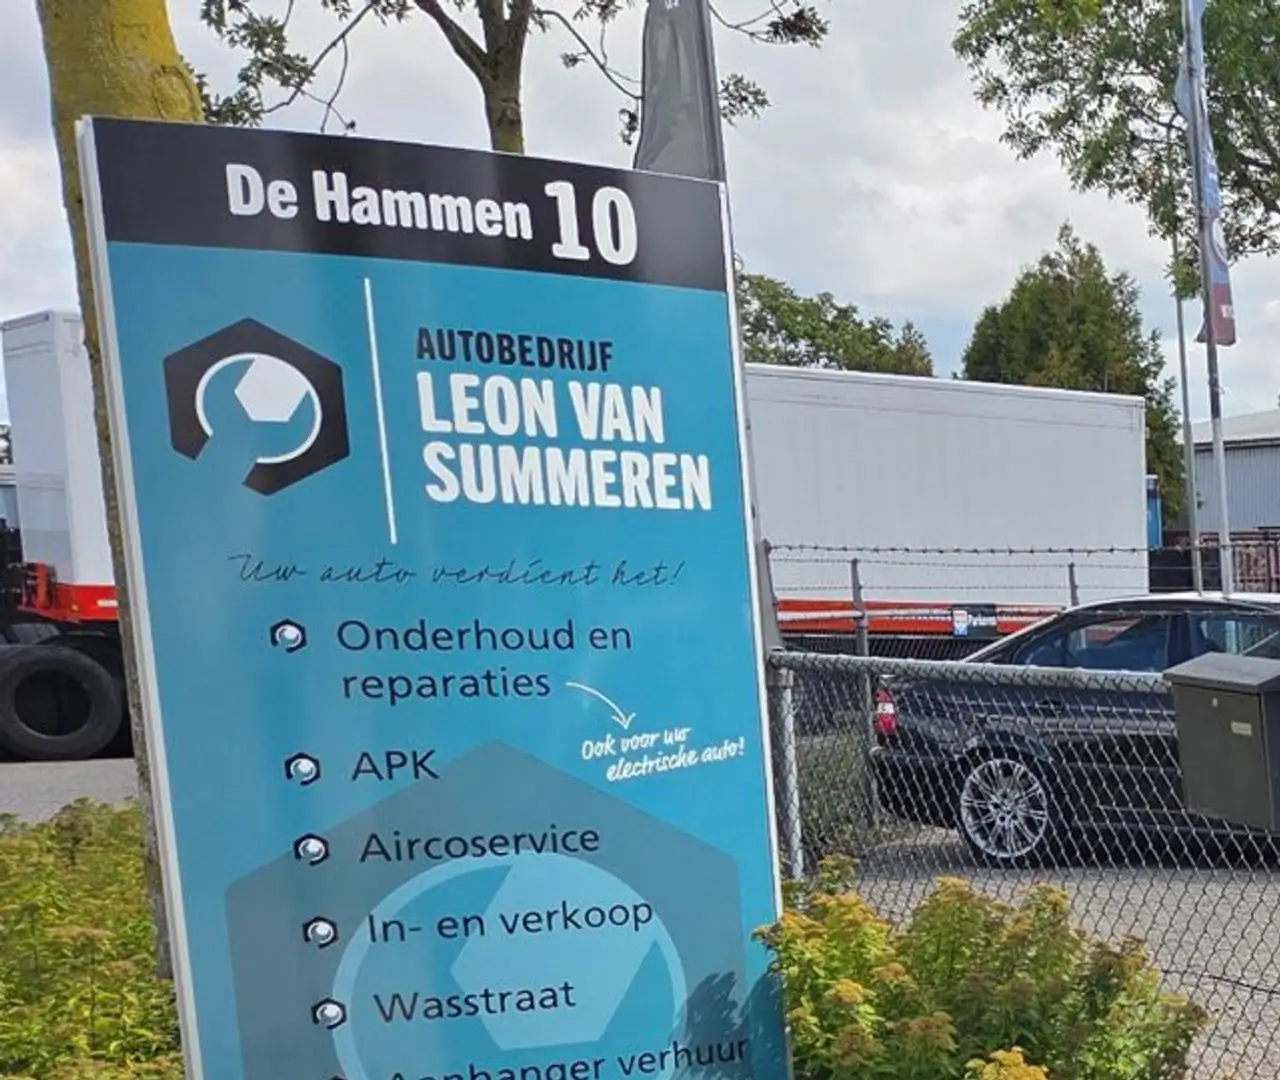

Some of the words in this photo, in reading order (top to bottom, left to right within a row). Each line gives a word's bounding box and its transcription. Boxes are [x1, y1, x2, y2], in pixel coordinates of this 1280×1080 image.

[225, 162, 299, 219] De
[312, 169, 533, 242] Hammen
[543, 179, 639, 267] 10
[416, 327, 614, 372] AUTOBEDRIJF
[416, 370, 558, 439] LEON
[572, 377, 665, 445] VAN
[422, 441, 714, 512] SUMMEREN
[227, 553, 306, 583] Uw
[319, 559, 418, 583] auto
[431, 557, 602, 586] verdient
[610, 559, 687, 587] het!
[336, 619, 576, 653] Onderhoud
[588, 624, 633, 651] en
[342, 667, 552, 706] reparaties
[351, 749, 439, 782] APK
[581, 733, 617, 761] Ook
[620, 732, 661, 753] voor
[663, 727, 693, 745] uw
[606, 745, 699, 782] electrische
[701, 736, 746, 763] auto!
[359, 824, 601, 864] Aircoservice
[367, 914, 422, 945] In-
[435, 914, 485, 940] en
[499, 899, 654, 937] verkoop
[373, 979, 577, 1024] Wasstraat
[617, 1037, 748, 1078] verhuur
